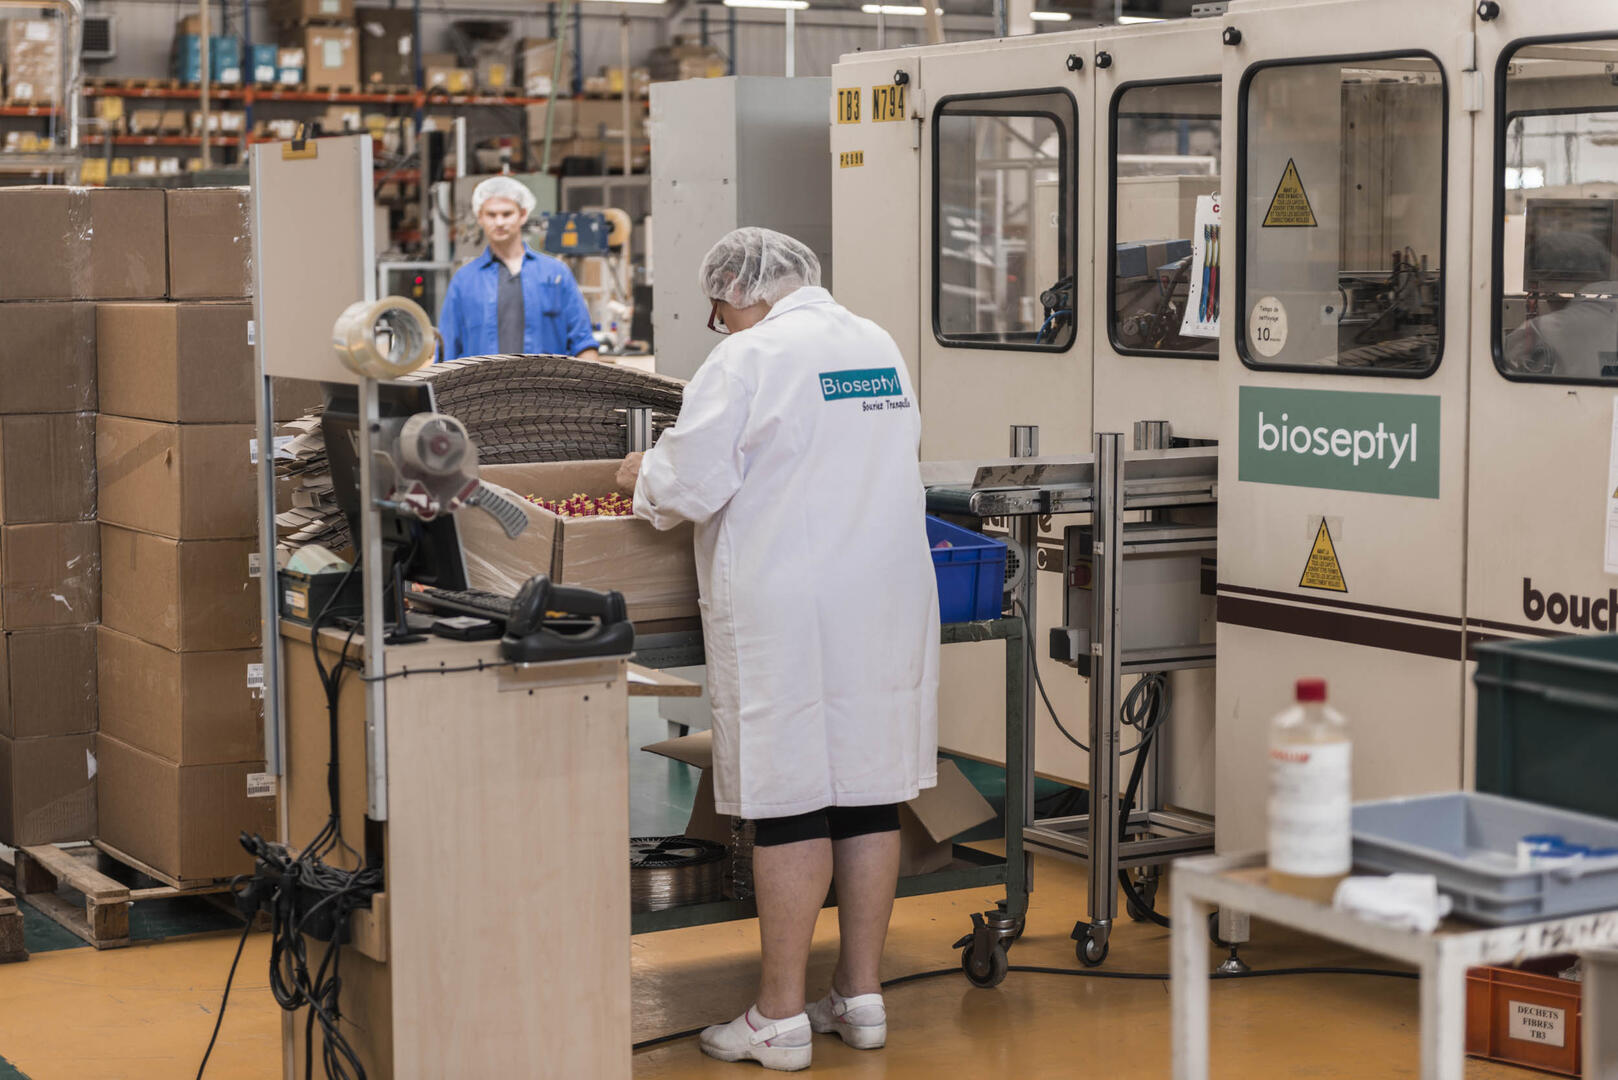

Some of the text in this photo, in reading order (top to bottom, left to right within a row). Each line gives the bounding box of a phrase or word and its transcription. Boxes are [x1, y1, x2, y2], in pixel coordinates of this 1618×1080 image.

[839, 90, 860, 120] TB3
[873, 86, 904, 121] N794
[1257, 327, 1271, 341] 10
[821, 374, 899, 395] Bioseptyl
[1258, 411, 1418, 469] bioseptyl
[1517, 1004, 1559, 1019] DECHETS
[1522, 1017, 1554, 1030] FIBRES
[1529, 1029, 1547, 1040] TB3
